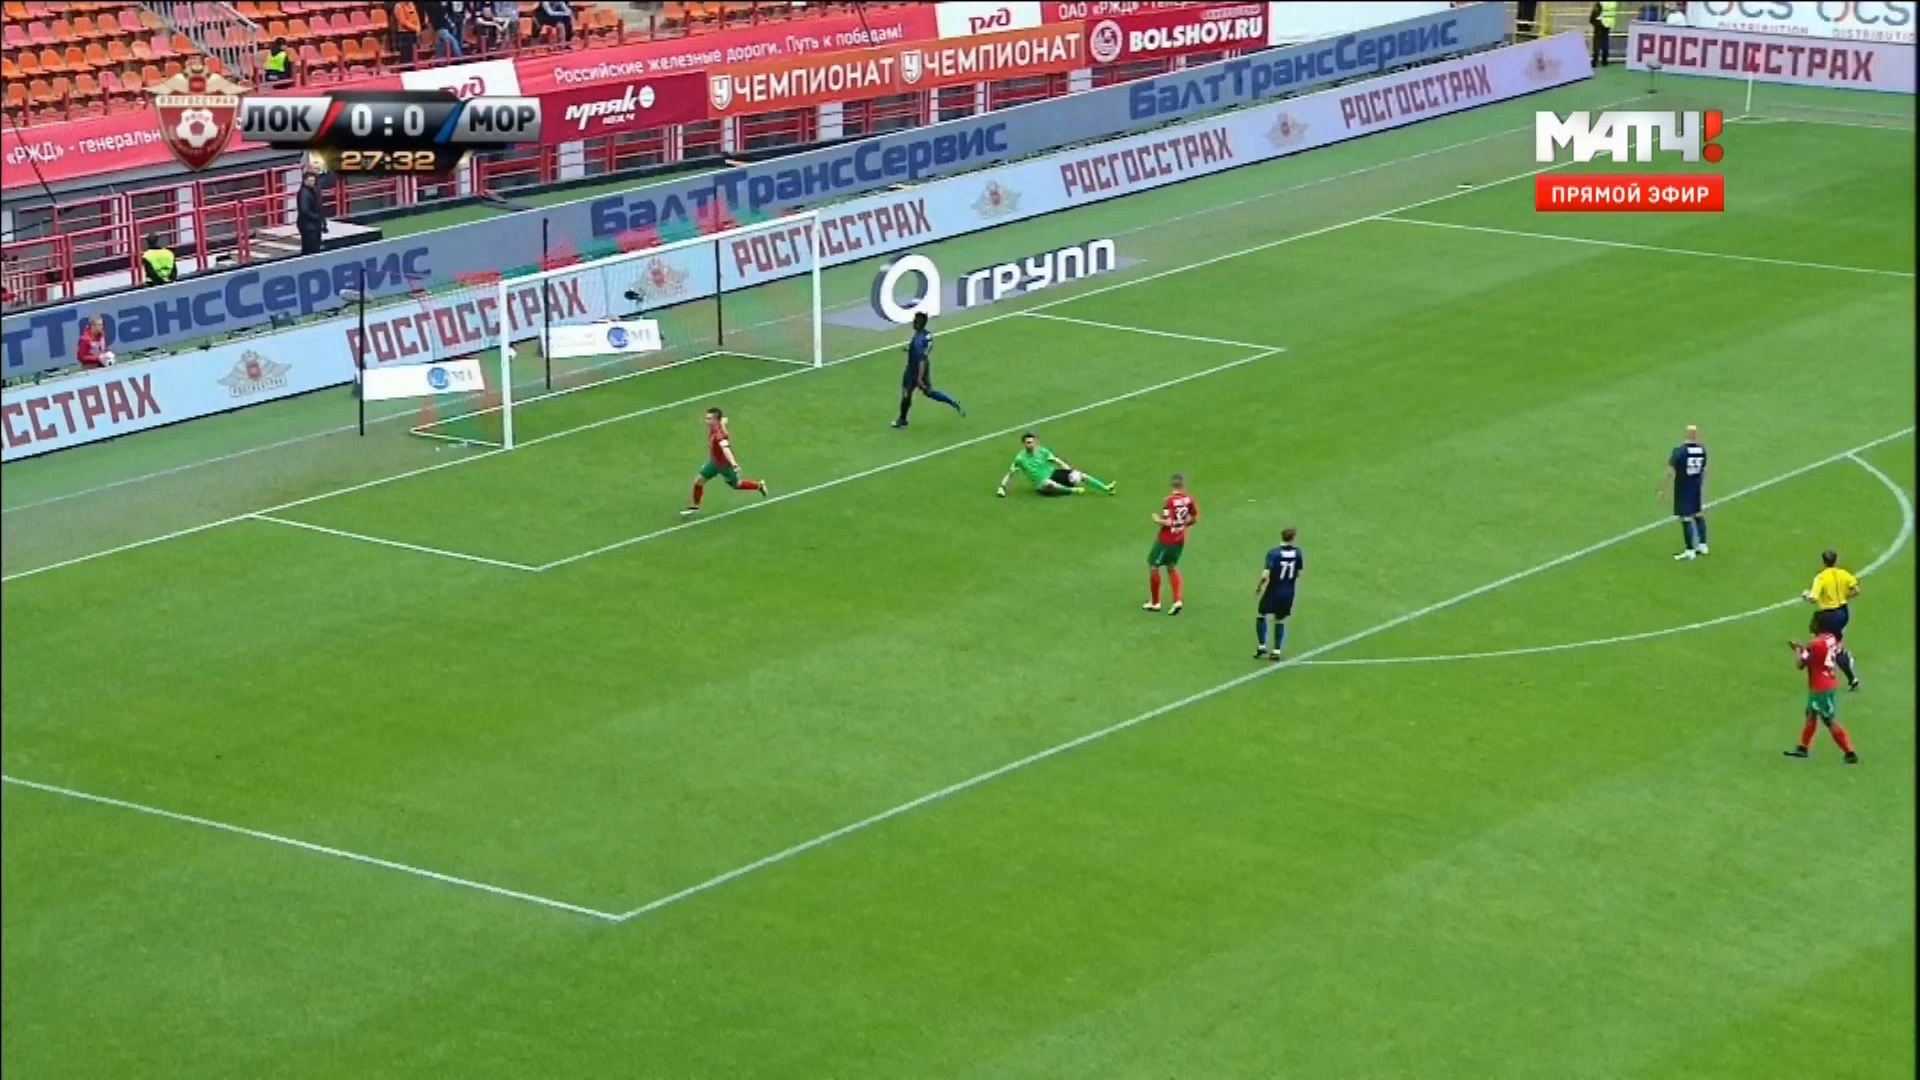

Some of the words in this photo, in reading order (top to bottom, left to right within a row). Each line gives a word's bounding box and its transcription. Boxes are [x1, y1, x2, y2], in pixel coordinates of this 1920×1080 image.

[1058, 3, 1088, 20] ОАО
[1129, 16, 1263, 53] BOLSHOY.RU
[1832, 28, 1916, 42] DISTRIBUTIO
[554, 60, 644, 84] Российские
[648, 50, 722, 71] железные
[726, 43, 782, 63] дороги.
[786, 35, 819, 54] Путь
[823, 37, 832, 47] к
[836, 23, 904, 45] победам!
[734, 57, 894, 103] ЧЕМПИОНАТ
[924, 33, 1080, 77] ЧЕМПИОНАТ
[1128, 19, 1458, 121] БалтТрансСервис
[1637, 33, 1875, 82] РОСГОССТРАХ
[1340, 65, 1492, 129] РОСГОССТРАХ
[6, 140, 64, 166] «РЖД»
[79, 129, 162, 154] генеральн
[1060, 127, 1233, 198] РОСГОССТРАХ
[591, 122, 1008, 238] БалтТрансСервис
[731, 198, 931, 278] РОСГОССТРАХ
[346, 277, 587, 369] РОСГОССТРАХ
[1, 373, 161, 448] ССТРАХ
[1279, 561, 1296, 580] 71
